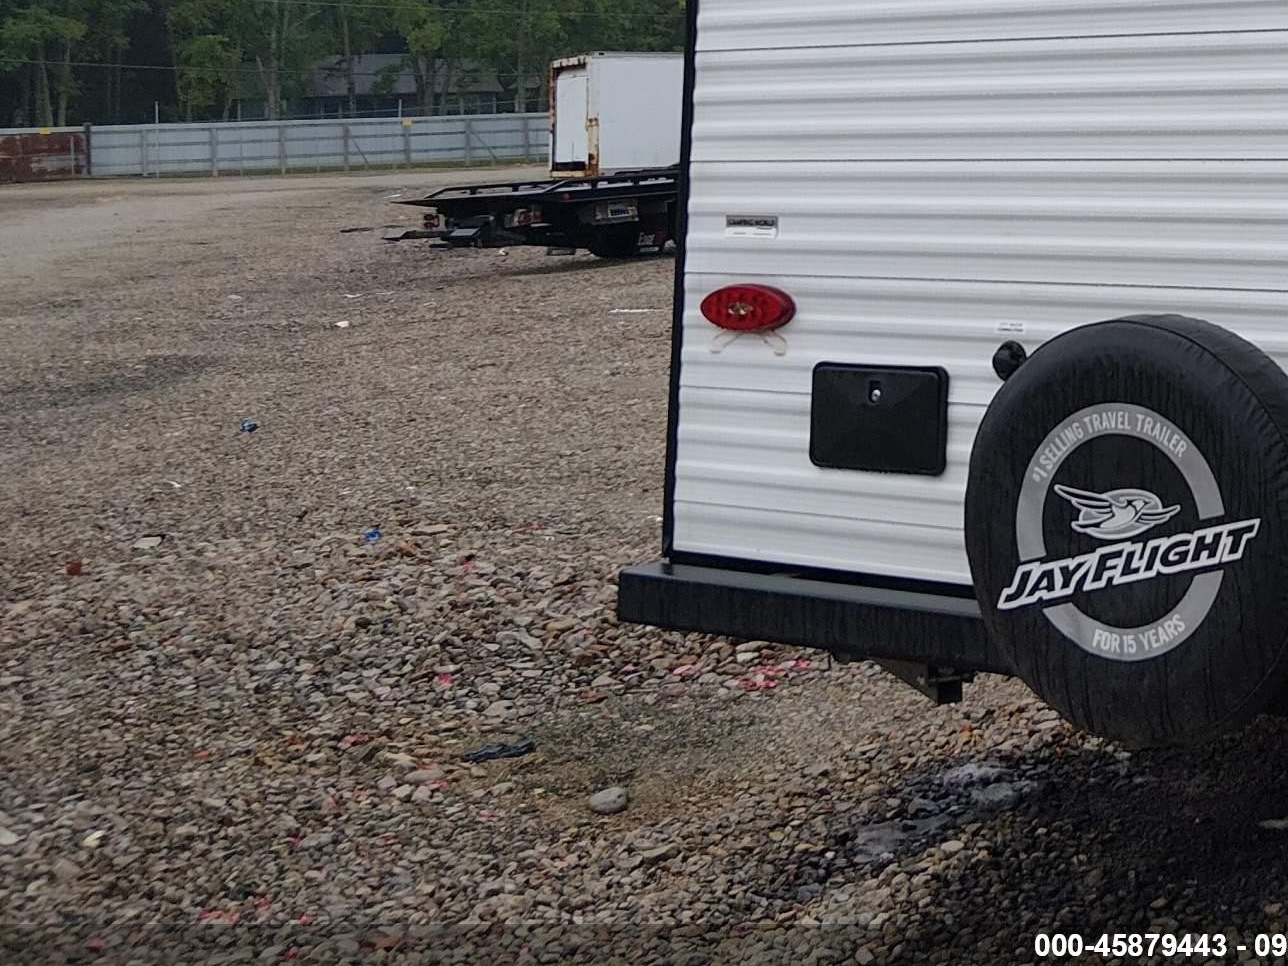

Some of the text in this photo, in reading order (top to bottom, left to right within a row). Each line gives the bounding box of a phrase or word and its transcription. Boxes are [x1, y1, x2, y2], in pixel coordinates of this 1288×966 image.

[1039, 422, 1084, 470] SELLING
[1083, 411, 1131, 434] TRAVEL
[1135, 413, 1188, 458] TRAILER
[1092, 613, 1186, 654] FOR 15 YEARS
